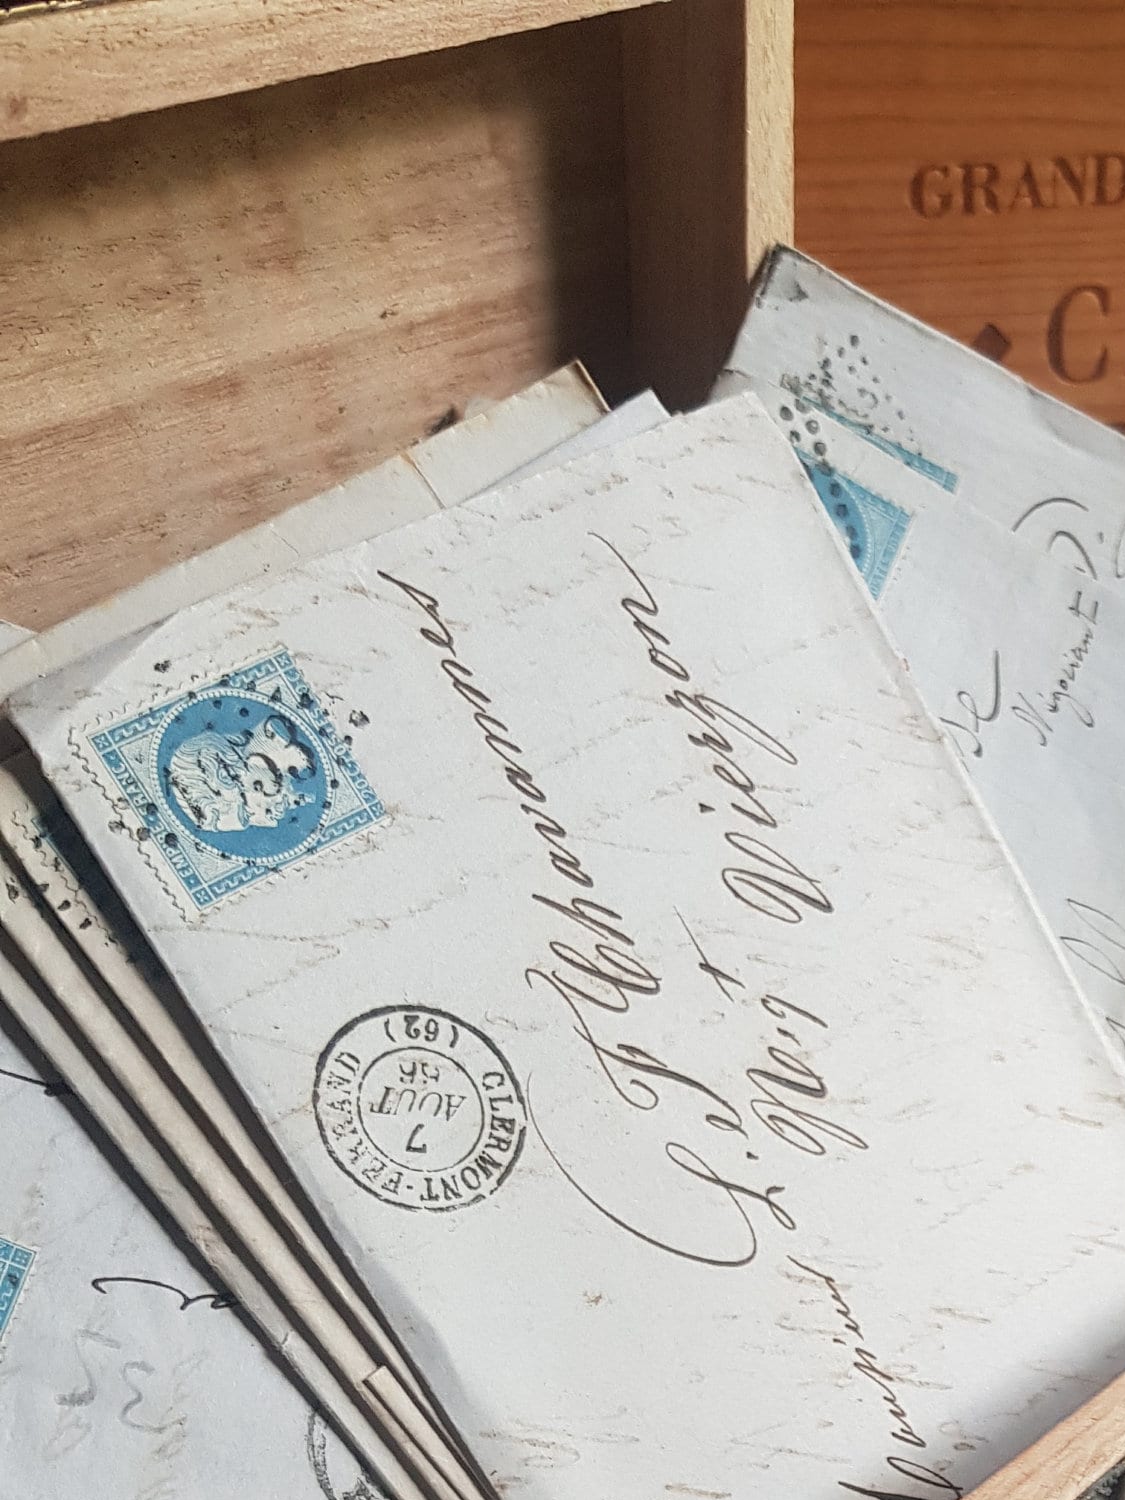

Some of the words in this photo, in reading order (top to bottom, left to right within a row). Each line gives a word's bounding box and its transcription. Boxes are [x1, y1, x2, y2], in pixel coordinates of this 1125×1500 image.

[384, 1014, 460, 1049] (62)
[369, 1086, 468, 1122] AOUT
[404, 1123, 428, 1154] 7
